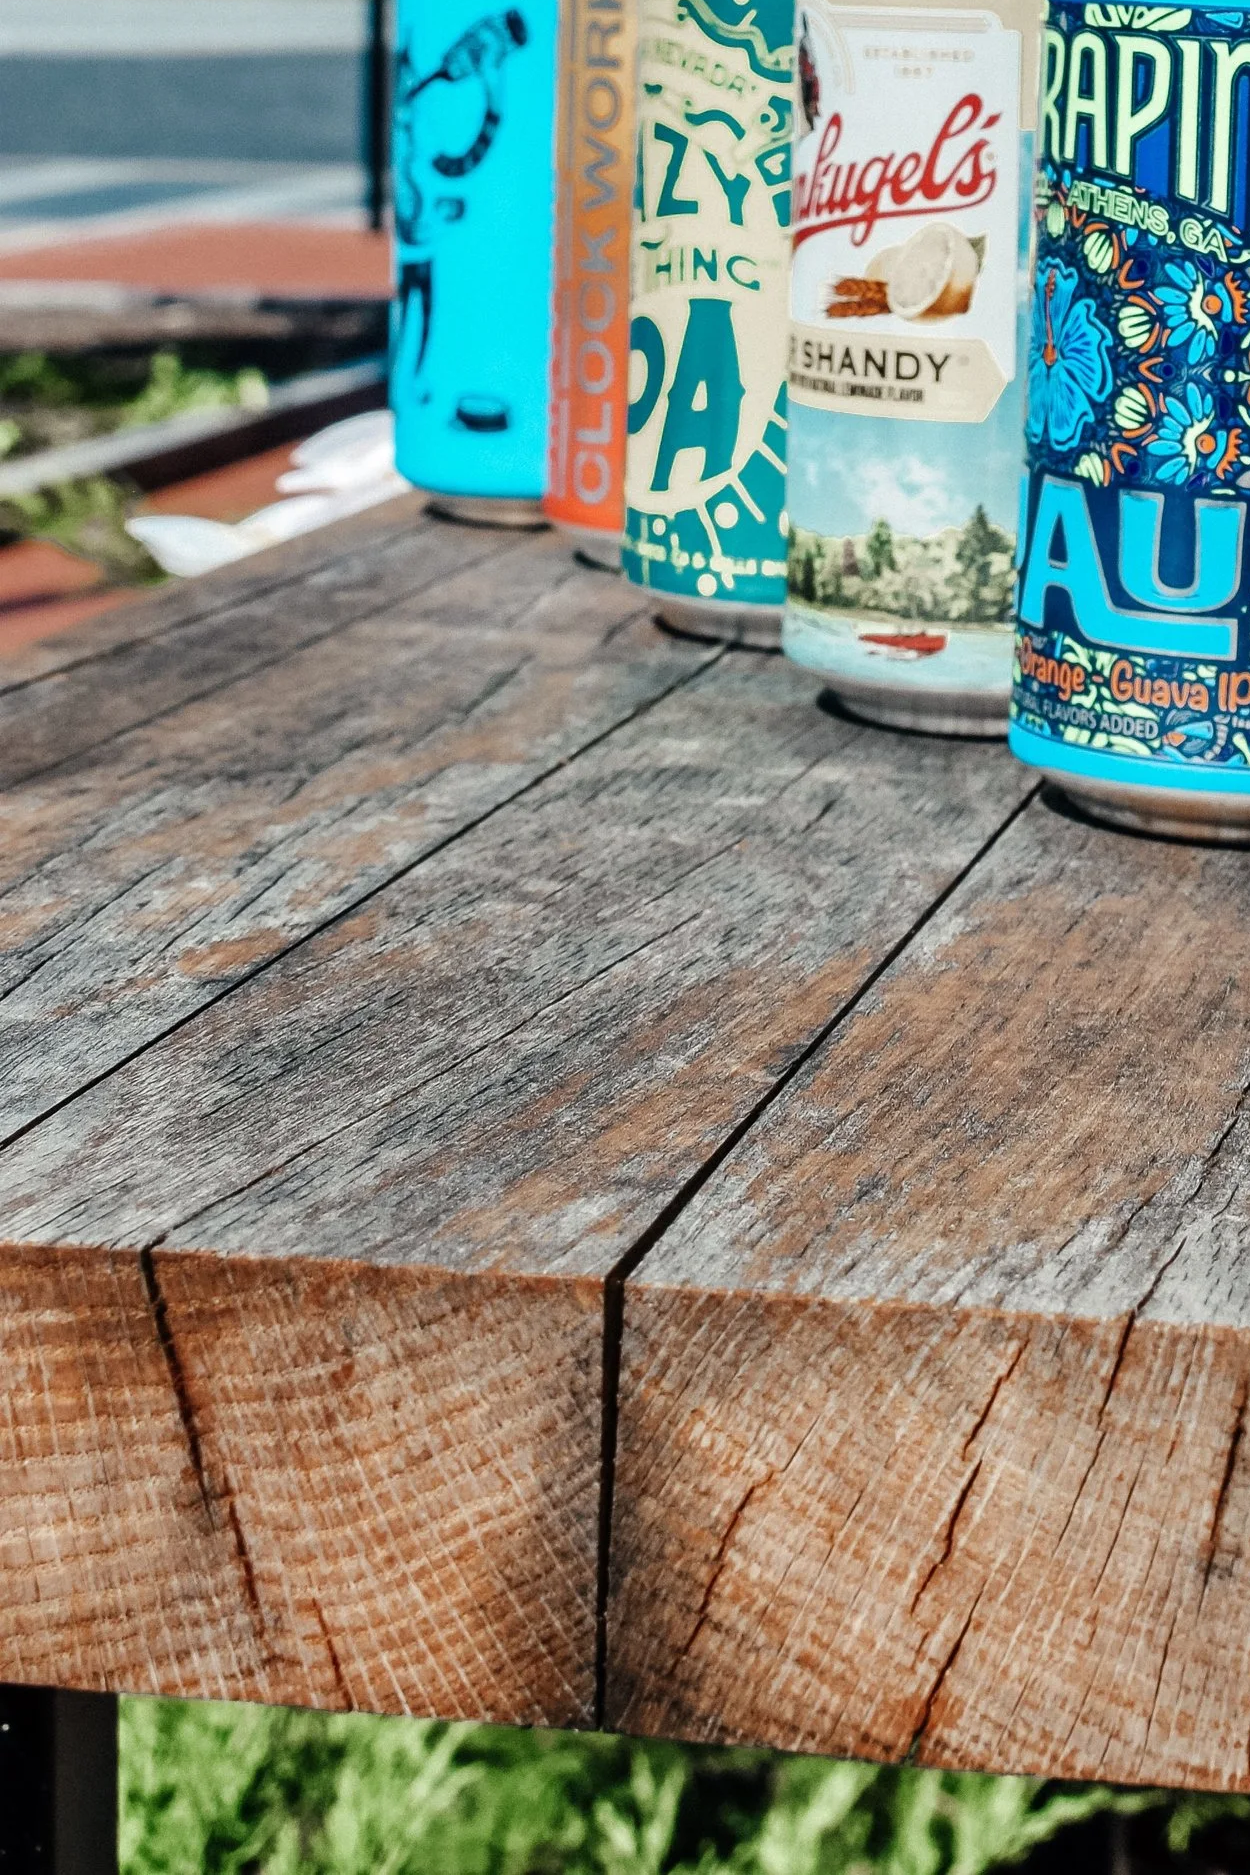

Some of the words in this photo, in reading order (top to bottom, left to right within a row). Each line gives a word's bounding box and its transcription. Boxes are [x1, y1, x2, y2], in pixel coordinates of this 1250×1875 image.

[633, 120, 752, 226] ZY
[1066, 180, 1177, 244] ATHENS,
[1179, 217, 1229, 263] GA
[803, 339, 949, 382] SHANDY
[1016, 474, 1247, 661] AU
[1019, 635, 1086, 701] Orange
[1110, 659, 1210, 714] Guava
[1042, 701, 1098, 730] FLAVORS
[1099, 713, 1160, 739] ADDED
